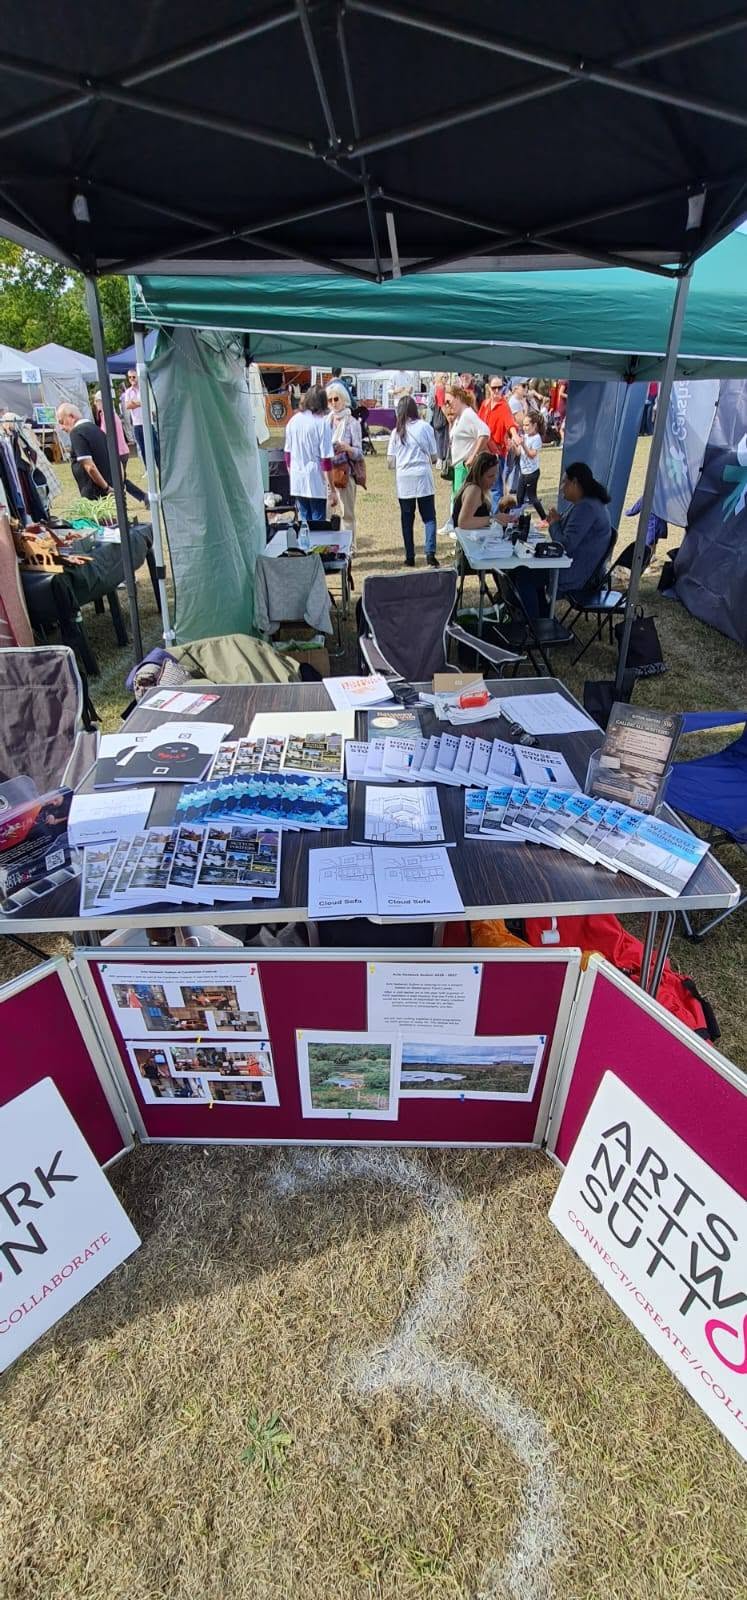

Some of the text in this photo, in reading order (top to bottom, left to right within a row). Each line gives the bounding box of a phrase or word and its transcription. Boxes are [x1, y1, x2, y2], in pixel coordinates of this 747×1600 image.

[521, 749, 552, 759] HOUSE
[523, 754, 562, 765] STORIES
[650, 822, 699, 850] WITHOUT
[601, 1121, 738, 1262] ARTS
[0, 1222, 48, 1282] N
